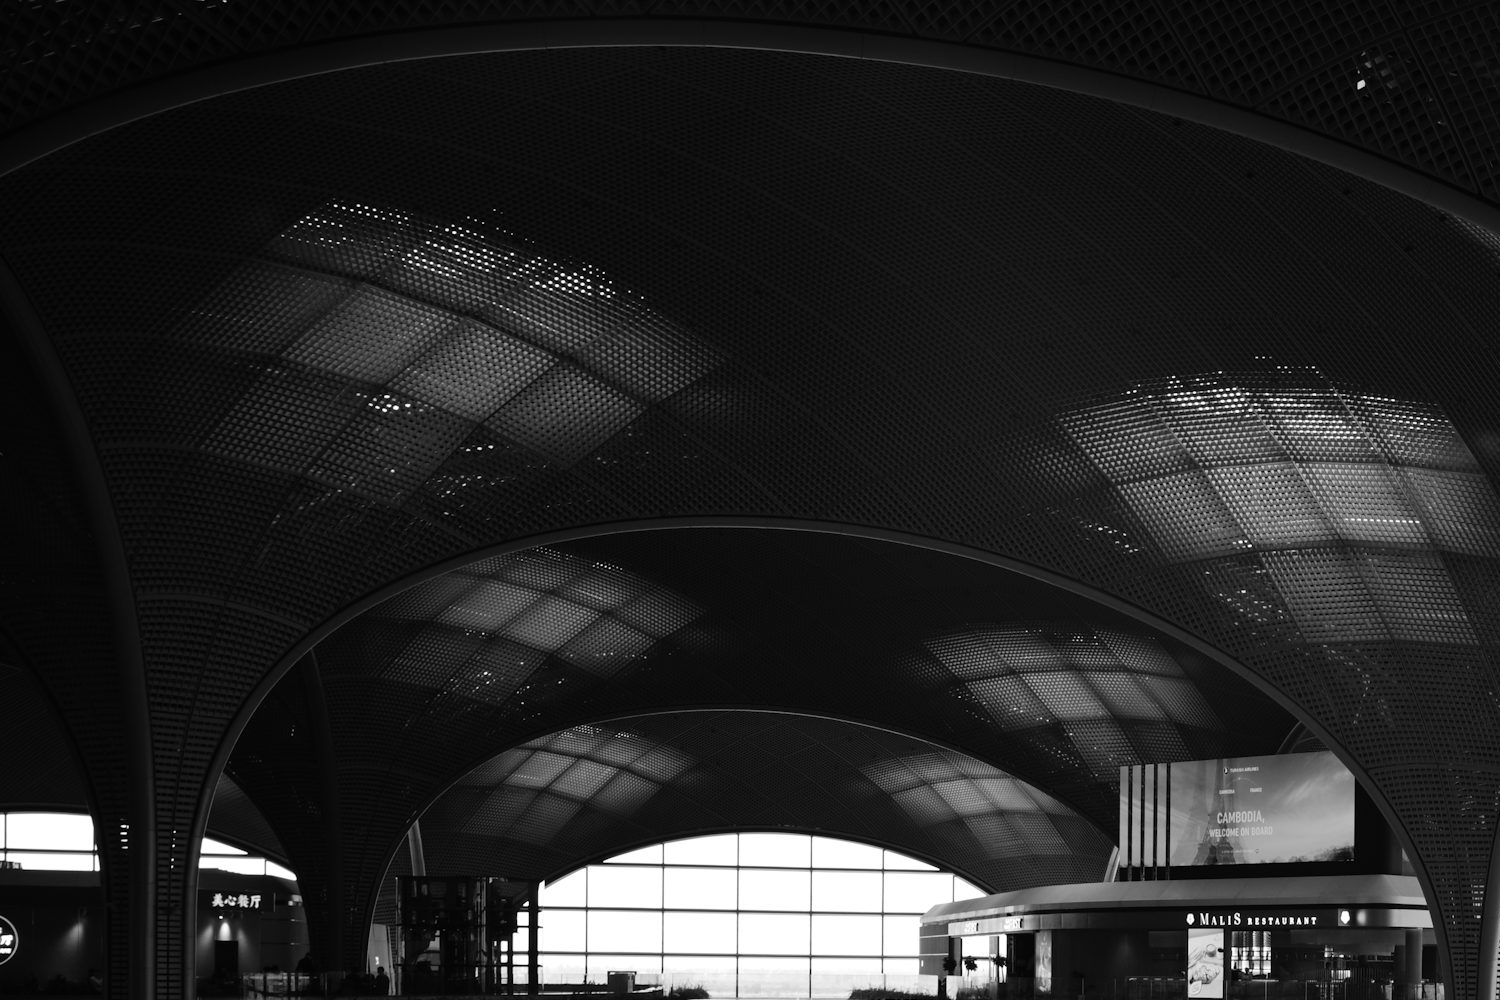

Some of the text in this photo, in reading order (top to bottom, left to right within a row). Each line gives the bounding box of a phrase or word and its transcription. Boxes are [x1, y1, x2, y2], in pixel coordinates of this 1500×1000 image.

[1216, 809, 1265, 824] CAMBODIA,
[1209, 826, 1273, 838] WELCOME ON BOARD
[1247, 916, 1317, 926] RESTAURANT
